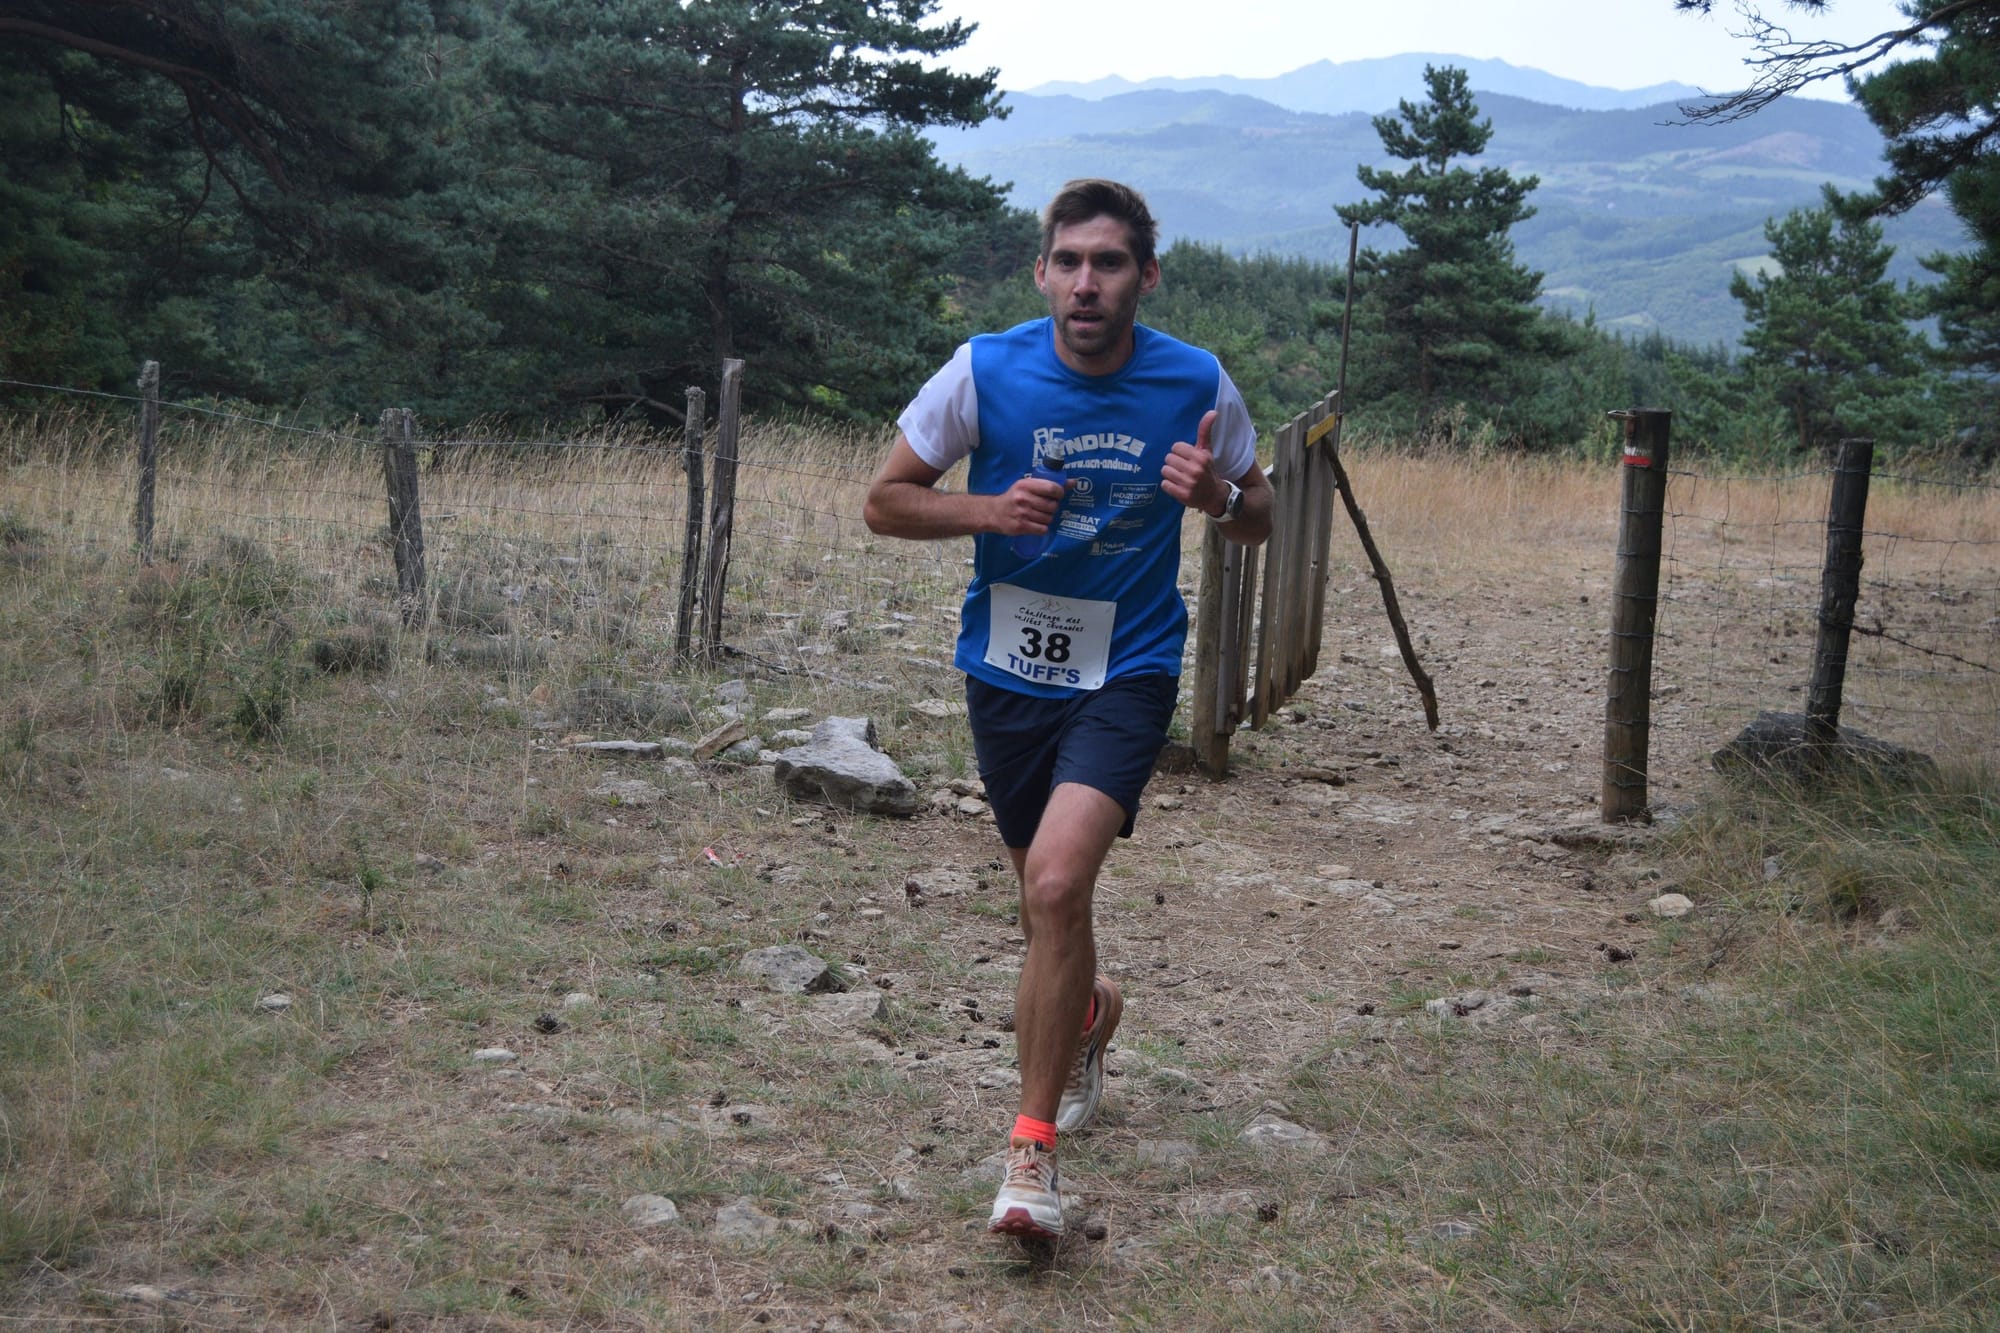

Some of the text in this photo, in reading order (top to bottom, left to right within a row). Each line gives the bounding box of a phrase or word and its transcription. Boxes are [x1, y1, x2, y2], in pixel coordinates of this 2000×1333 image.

[1065, 433, 1146, 458] NDUZE
[1077, 480, 1089, 491] U
[1080, 515, 1100, 526] BAT
[1019, 606, 1060, 623] Challenge
[1018, 626, 1072, 663] 38
[1008, 653, 1080, 685] TUFF'S
